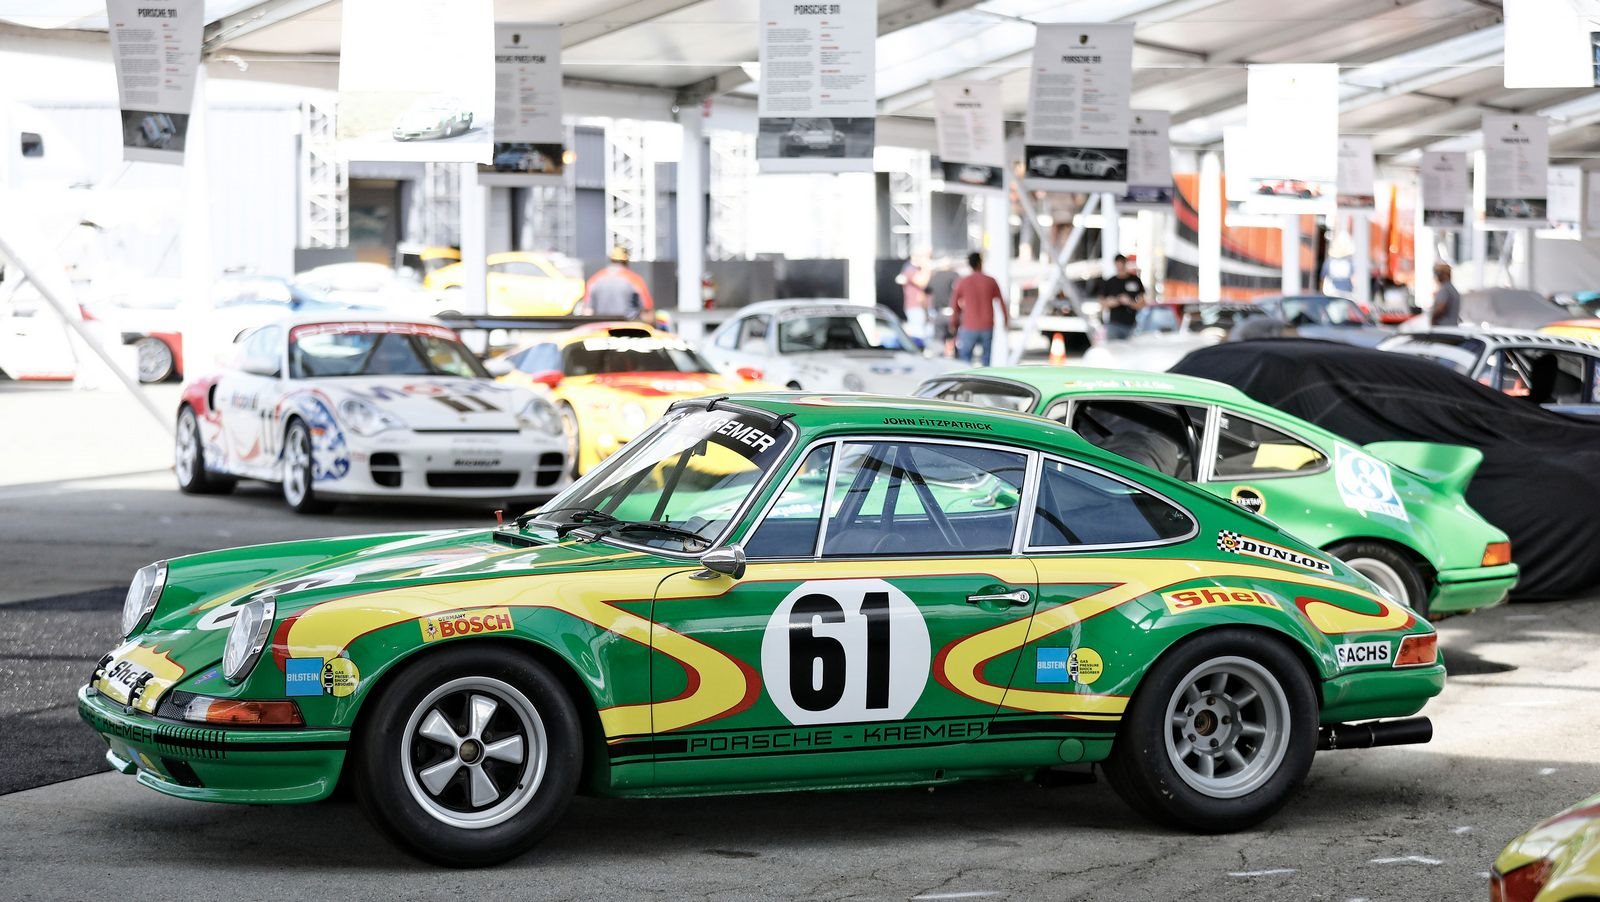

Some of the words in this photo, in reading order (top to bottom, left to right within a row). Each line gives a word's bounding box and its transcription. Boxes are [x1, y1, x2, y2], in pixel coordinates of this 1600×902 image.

[138, 8, 167, 18] PORSCHE
[794, 5, 827, 15] PORSCHE
[829, 5, 841, 15] 911
[883, 417, 916, 426] JOHN
[919, 418, 993, 431] FITZPATRICK
[704, 417, 776, 453] KREMER
[1240, 540, 1330, 573] DUNLOP
[1170, 589, 1277, 610] Shell
[437, 613, 466, 622] GERMANY
[439, 613, 512, 638] BOSCH
[788, 592, 891, 711] 61
[1337, 644, 1389, 664] SACHS
[1037, 661, 1066, 670] BILSTEIN
[287, 673, 319, 682] BILSTEIN
[690, 730, 834, 752] PORSCHE
[863, 721, 988, 743] KREMER
